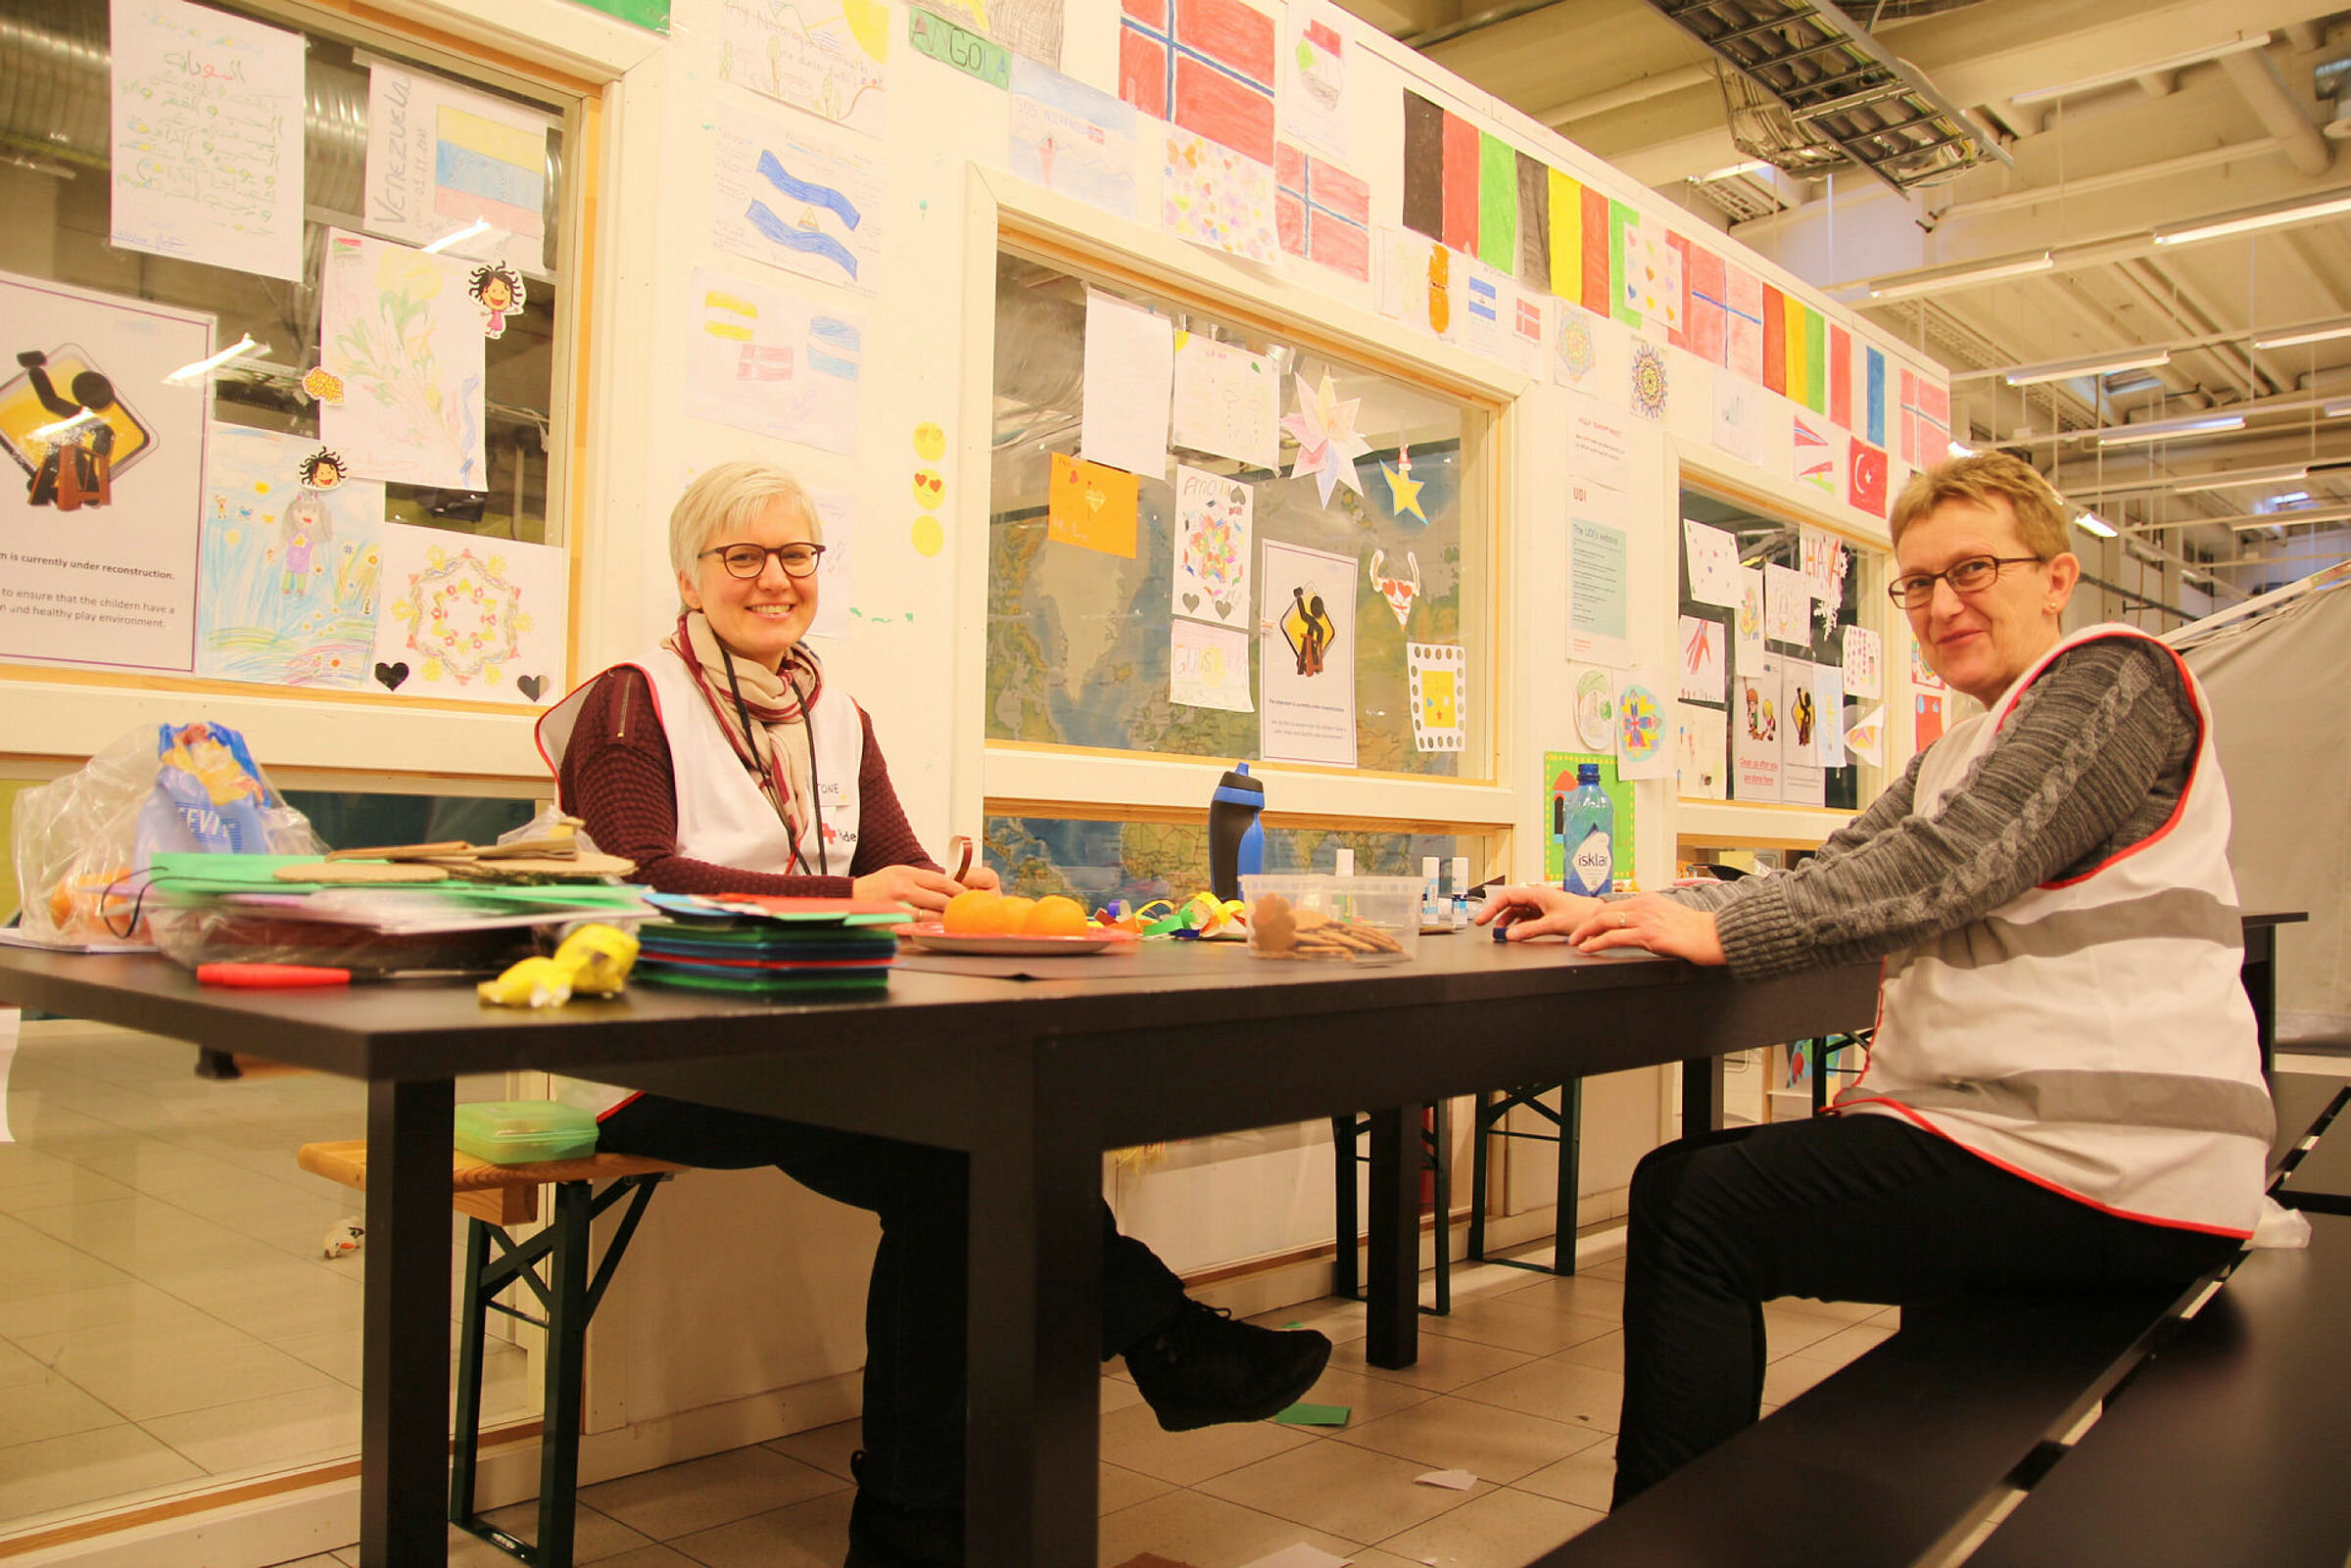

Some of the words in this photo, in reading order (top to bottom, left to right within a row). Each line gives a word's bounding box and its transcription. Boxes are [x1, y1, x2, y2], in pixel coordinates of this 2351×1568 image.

[911, 12, 1009, 90] ANGOLA
[1573, 487, 1587, 501] UDI
[10, 552, 19, 561] is
[21, 554, 68, 568] currently
[70, 560, 99, 571] under
[102, 564, 175, 580] reconstruction.
[2, 589, 14, 597] to
[16, 591, 53, 601] ensure
[56, 593, 76, 604] that
[80, 595, 98, 606] the
[100, 597, 141, 610] childern
[142, 602, 167, 614] have
[32, 605, 72, 620] healthy
[74, 610, 97, 623] play
[99, 614, 167, 628] environment.
[817, 784, 840, 794] ONE
